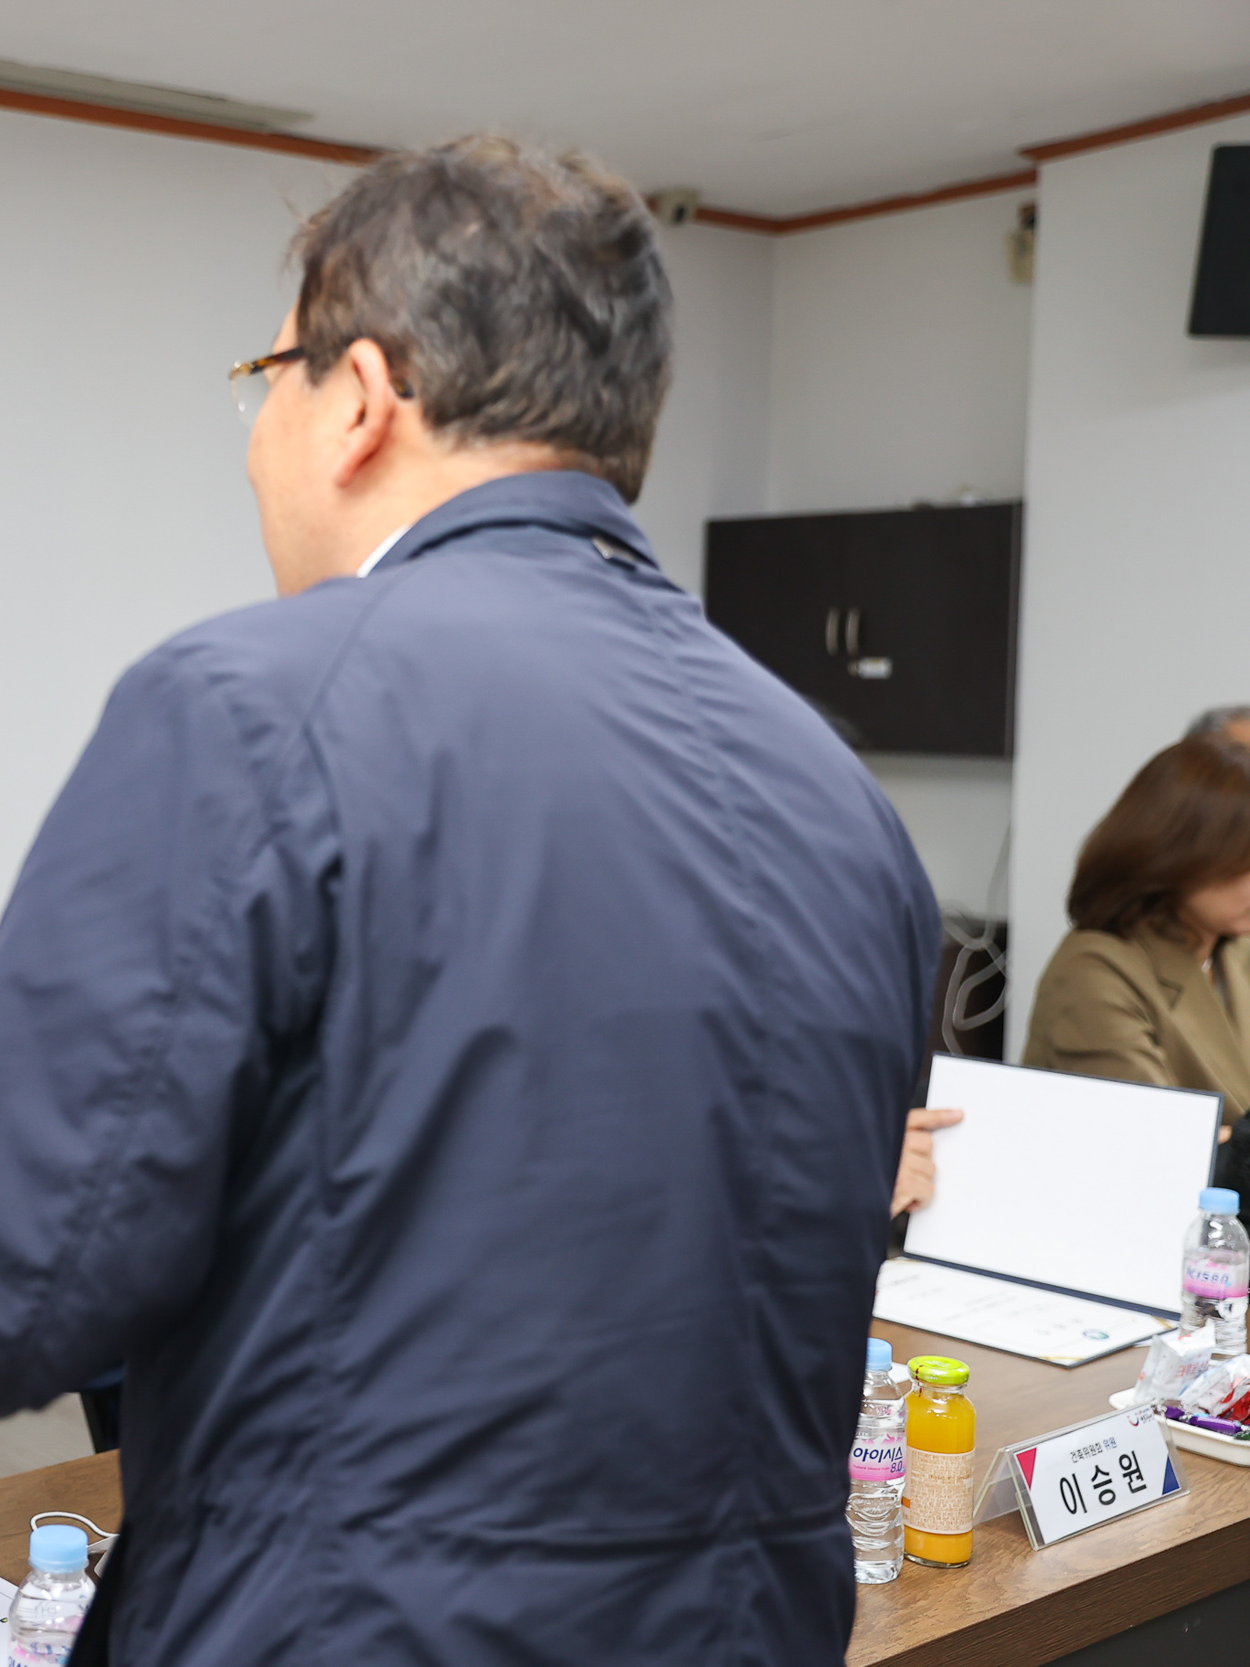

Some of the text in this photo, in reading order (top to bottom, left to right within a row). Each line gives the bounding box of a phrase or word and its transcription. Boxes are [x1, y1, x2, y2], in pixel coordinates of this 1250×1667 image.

[853, 1446, 903, 1463] 아이시스
[1069, 1437, 1117, 1463] 건축위원회 위원
[890, 1461, 903, 1473] 8.0
[1059, 1450, 1147, 1515] 이승원
